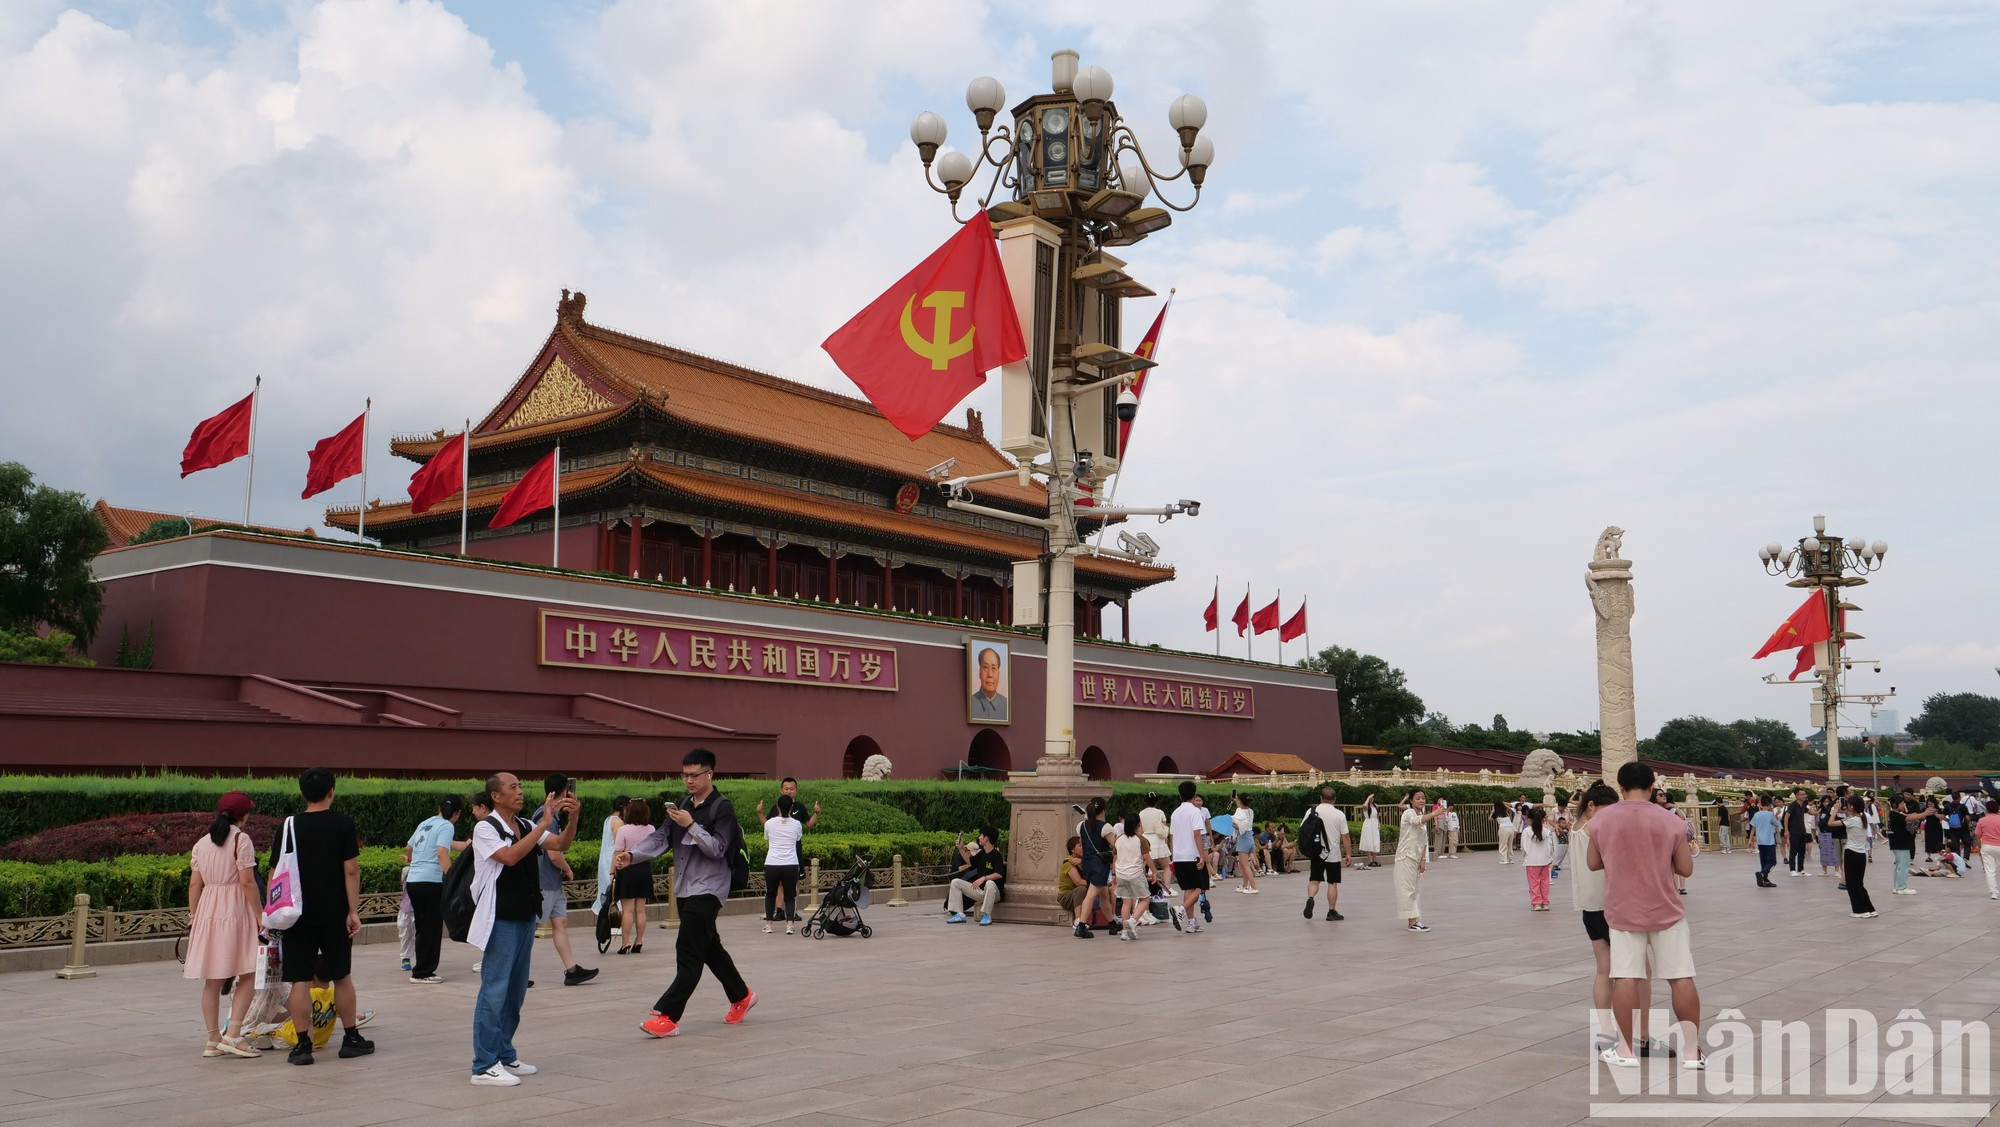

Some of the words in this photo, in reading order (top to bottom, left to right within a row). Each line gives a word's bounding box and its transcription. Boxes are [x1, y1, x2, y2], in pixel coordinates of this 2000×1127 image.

[565, 623, 882, 682] 中华人民共和国万岁
[1080, 675, 1245, 712] 世界人民大团结万岁
